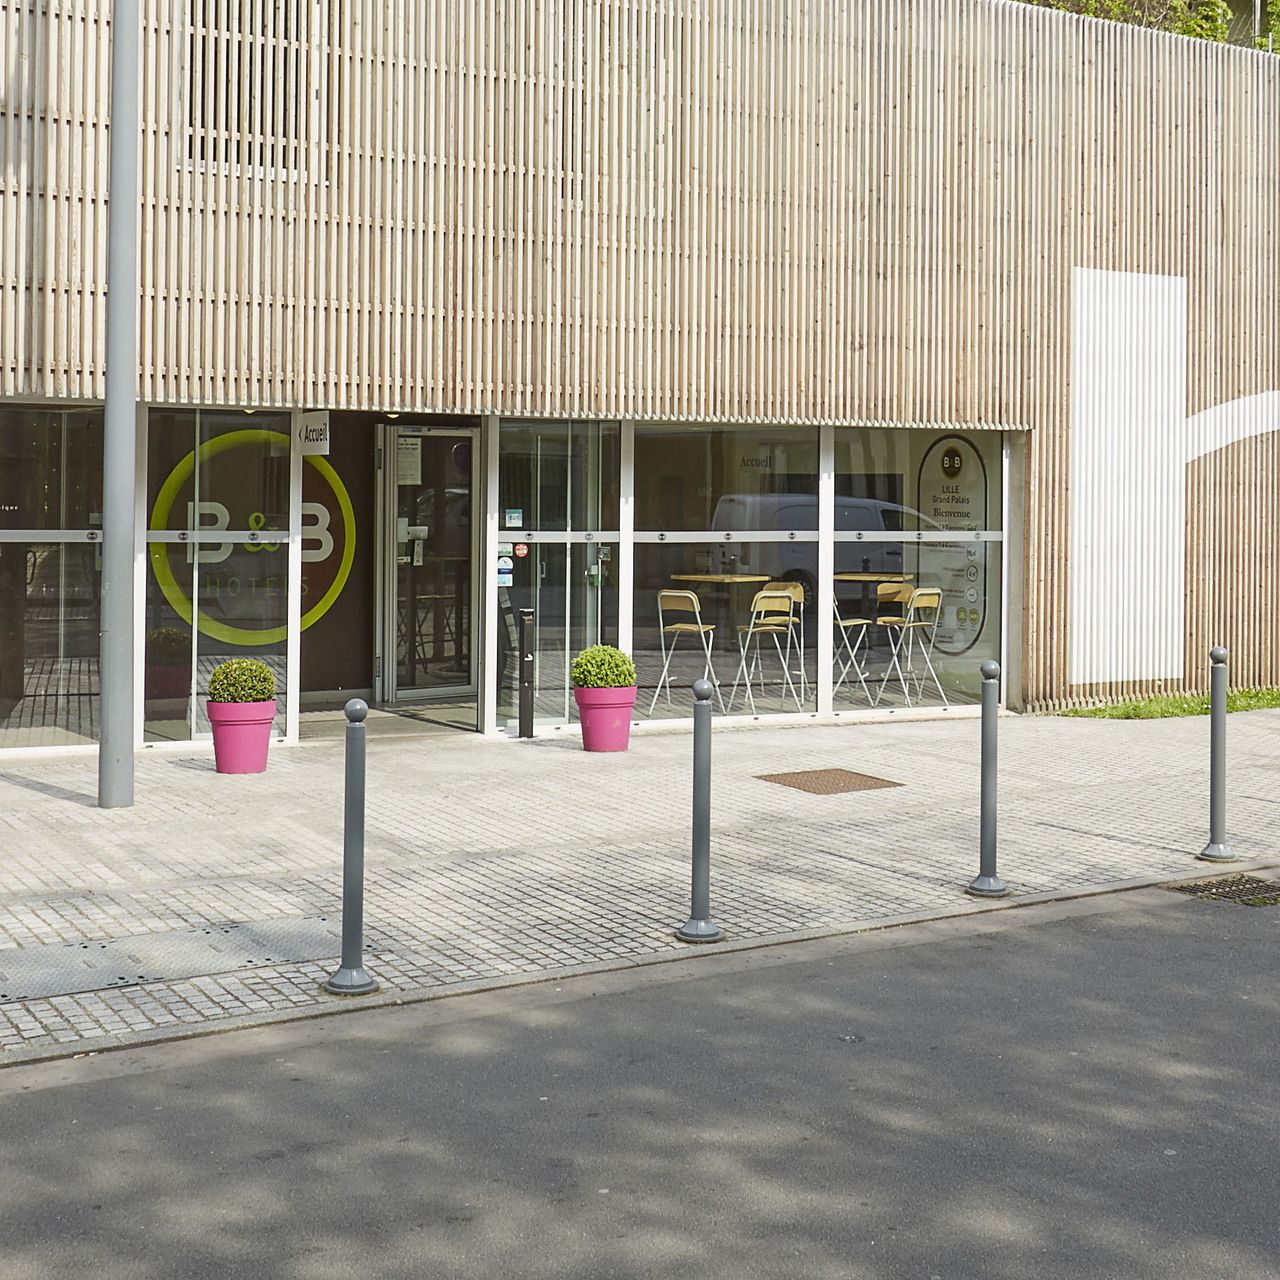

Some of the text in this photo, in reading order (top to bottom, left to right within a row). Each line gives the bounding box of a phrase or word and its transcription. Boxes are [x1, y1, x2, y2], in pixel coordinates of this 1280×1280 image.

[304, 423, 327, 442] Accueil
[740, 455, 772, 468] Accueil
[942, 485, 960, 494] LILLE
[932, 495, 970, 505] Grand Palais
[933, 507, 971, 519] Bienvenue
